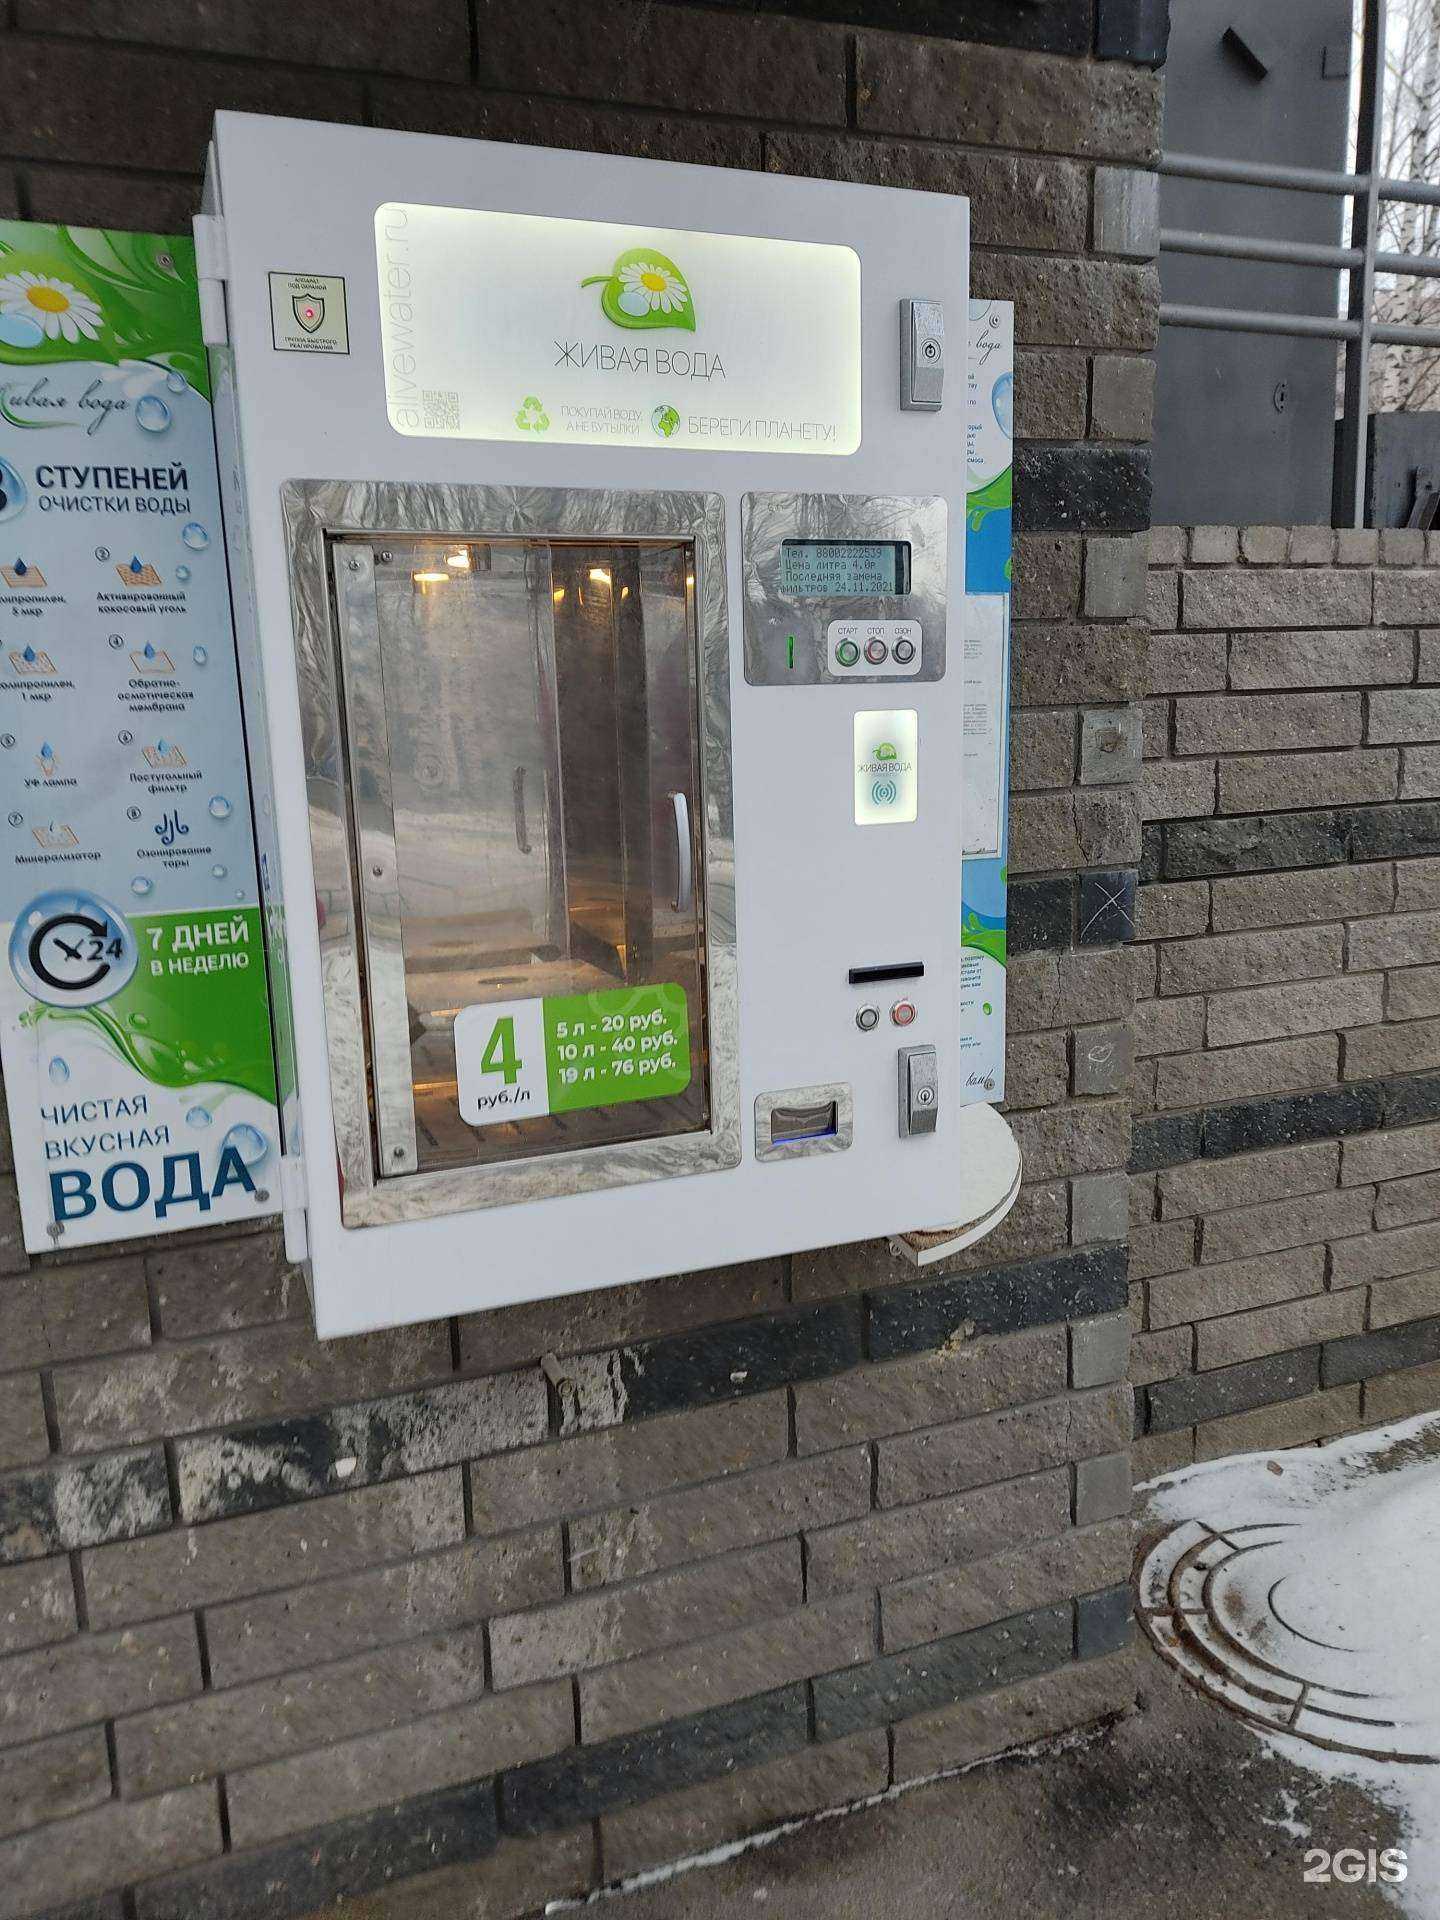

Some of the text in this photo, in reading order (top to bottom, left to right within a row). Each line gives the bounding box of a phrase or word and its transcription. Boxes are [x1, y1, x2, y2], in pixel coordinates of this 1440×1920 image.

[383, 207, 419, 428] alivewater.ru
[554, 341, 726, 381] ЖИВАЯ ВОДА
[560, 405, 612, 419] ПОКУПАЙ
[566, 420, 641, 436] А НЕ БУТЫЛКИ
[688, 416, 837, 442] БЕРЕГИ ПЛАНЕТУ!
[36, 462, 188, 490] СТУПЕНЕЙ
[38, 495, 191, 516] ОЧИСТКИ ВОДЫ
[785, 548, 809, 558] Тел.
[785, 560, 811, 570] Цена
[816, 562, 847, 570] литра
[785, 572, 882, 582] Последняя замена
[835, 581, 894, 592] 24.11.2021
[98, 604, 187, 615] кокосовый уголь
[837, 627, 858, 635] СТАРТ
[867, 627, 885, 635] СТОП
[894, 627, 912, 635] ОЗОН
[117, 691, 194, 701] осмотическая
[128, 702, 186, 713] мембрана
[858, 762, 912, 774] ЖИВАЯ ВОДА
[43, 778, 78, 788] лампа
[129, 769, 203, 783] Постугольный
[147, 784, 188, 795] фильтр
[15, 851, 101, 865] Минерализатор
[145, 915, 250, 953] 7 ДНЕЙ
[150, 951, 250, 977] В НЕДЕЛЮ
[556, 1021, 568, 1039] 5
[572, 1022, 585, 1037] л
[601, 1014, 625, 1033] 20
[629, 1008, 667, 1033] руб.
[480, 1016, 523, 1085] 4
[557, 1043, 578, 1062] 10
[582, 1043, 595, 1058] л
[611, 1036, 636, 1054] 40
[640, 1029, 678, 1051] руб.
[558, 1066, 579, 1085] 19
[583, 1066, 595, 1082] л
[611, 1059, 634, 1077] 76
[638, 1052, 676, 1076] руб.
[477, 1087, 531, 1111] руб./л
[40, 1094, 148, 1126] ЧИСТАЯ
[44, 1124, 171, 1161] ВКУСНАЯ
[49, 1146, 257, 1221] ВОДА
